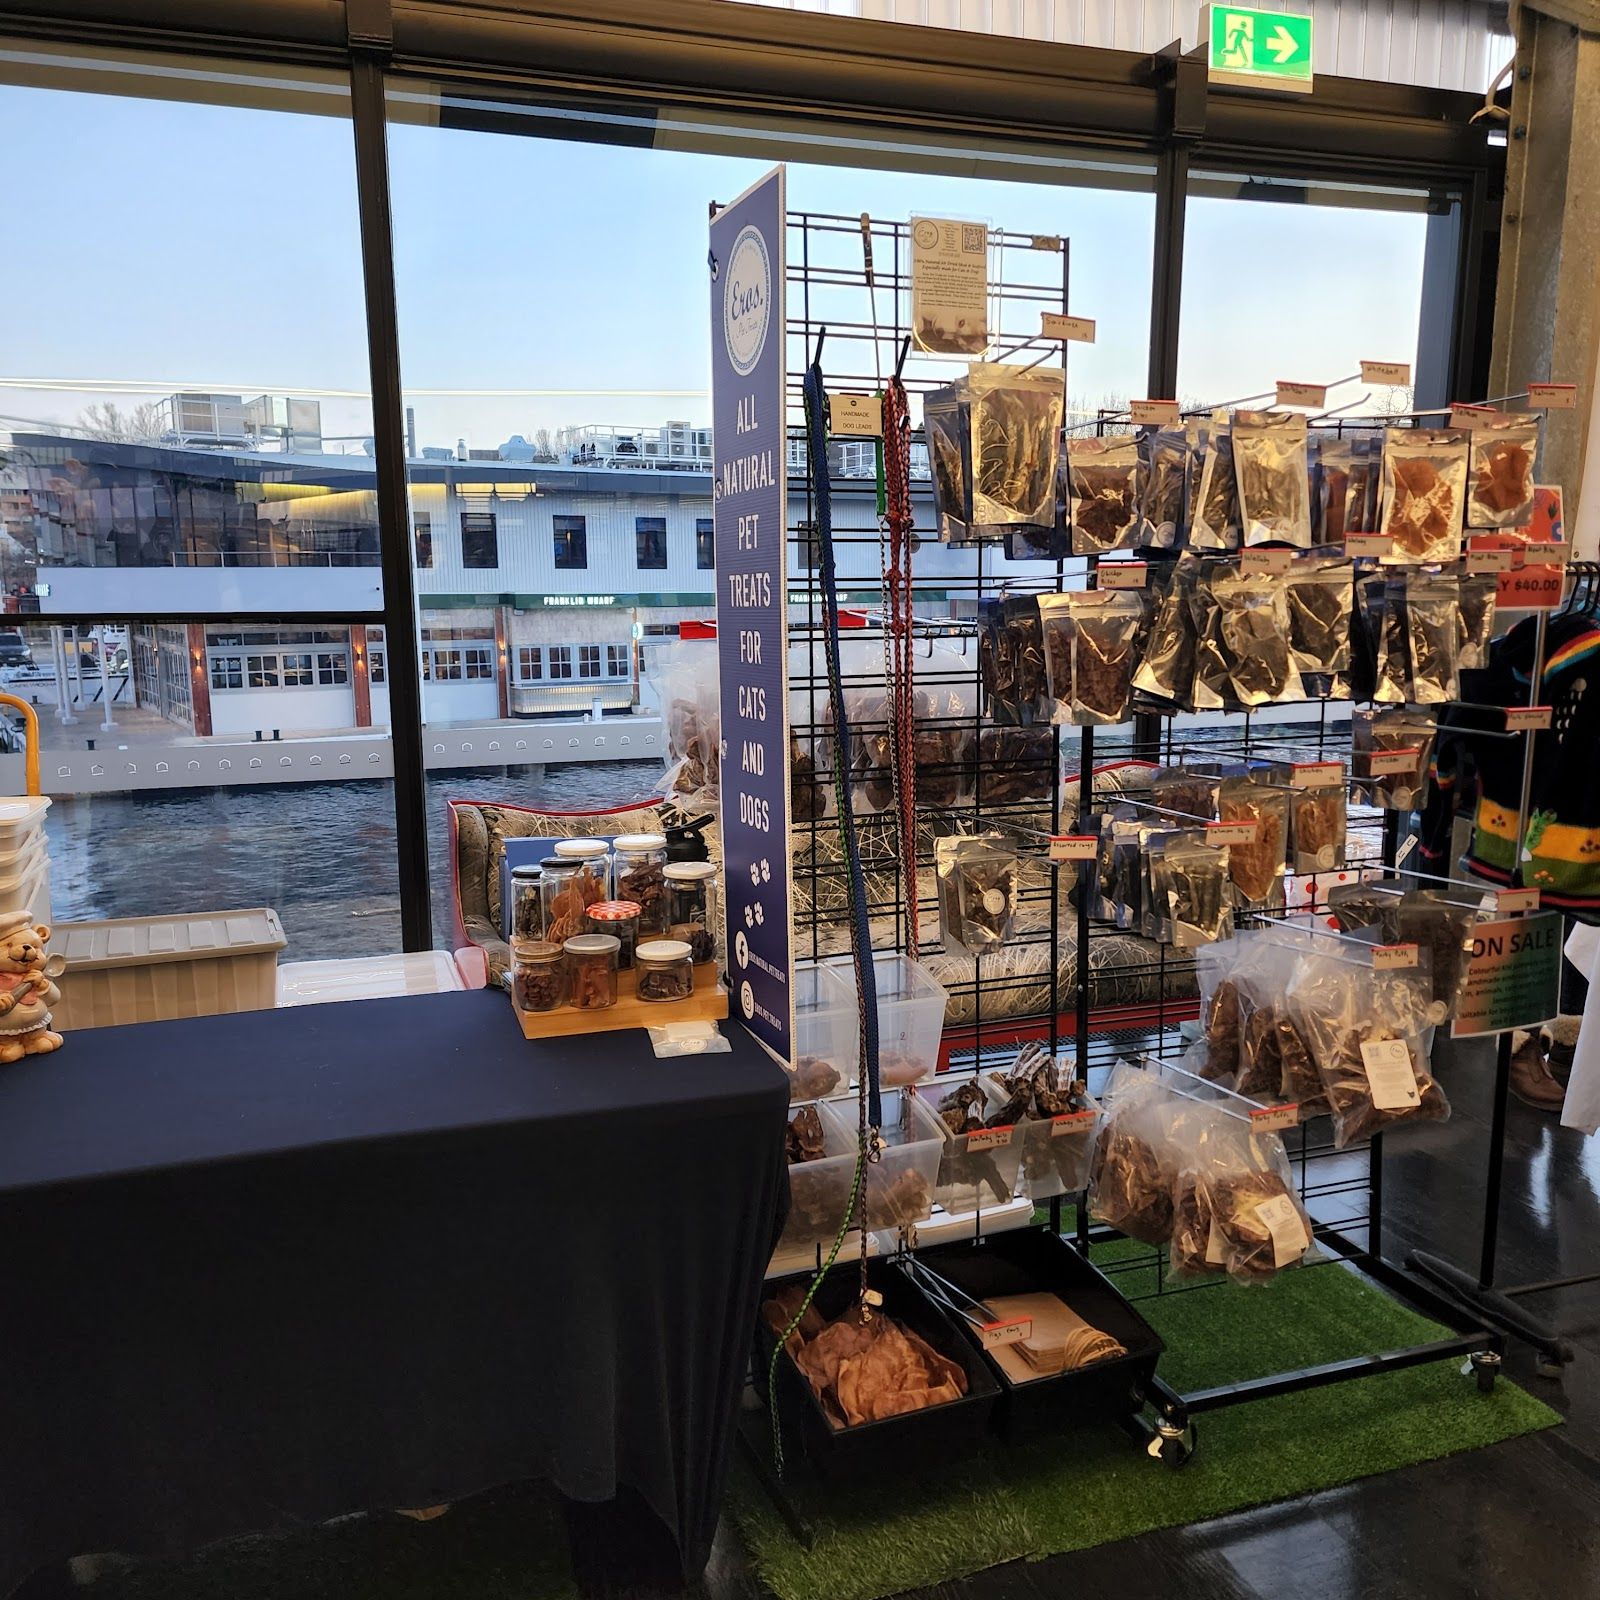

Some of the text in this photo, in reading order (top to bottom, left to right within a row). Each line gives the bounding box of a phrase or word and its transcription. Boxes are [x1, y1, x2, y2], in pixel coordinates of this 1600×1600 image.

[736, 394, 759, 434] ALL
[840, 410, 870, 418] HANDMADE
[723, 450, 776, 497] NATURAL
[738, 514, 759, 550] PET
[544, 596, 616, 606] FRANKLIN WHARF
[729, 573, 771, 608] TREATS
[1514, 579, 1560, 591] $40.00
[740, 630, 762, 664] FOR
[738, 686, 766, 721] CATS
[742, 740, 764, 776] AND
[740, 792, 770, 832] DOGS
[1472, 928, 1555, 959] ON SALE
